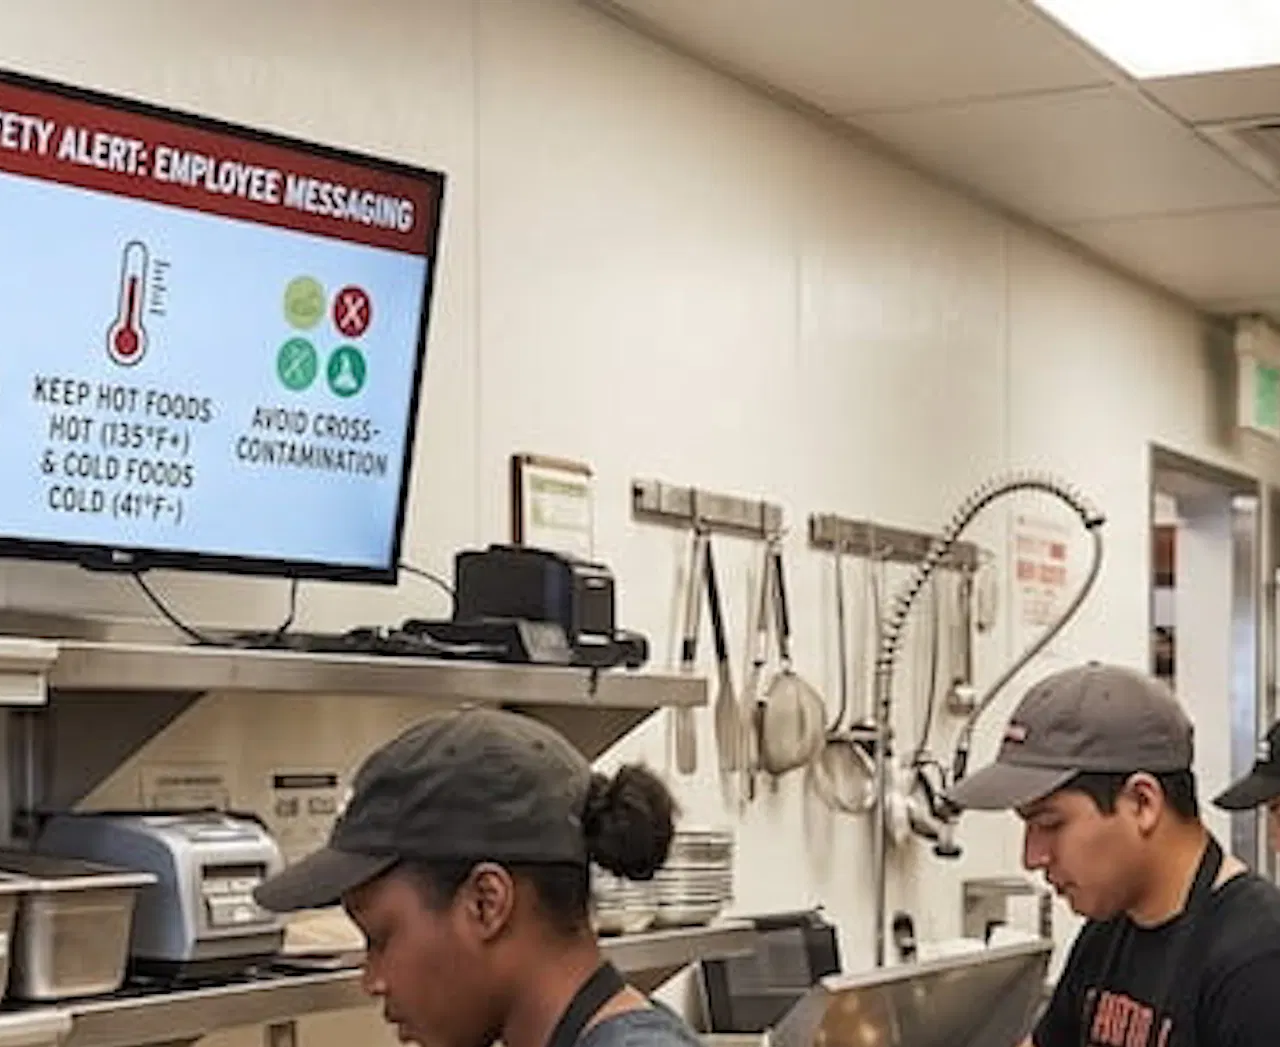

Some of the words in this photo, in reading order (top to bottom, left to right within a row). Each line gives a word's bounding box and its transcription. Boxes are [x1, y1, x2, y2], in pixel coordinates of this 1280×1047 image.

[57, 126, 147, 176] ALERT:
[153, 146, 282, 205] EMPLOYEE
[284, 172, 415, 232] MESSAGING
[33, 373, 90, 406] KEEP
[96, 382, 139, 413] HOT
[145, 389, 213, 424] FOODS
[48, 412, 94, 443] HOT
[251, 405, 309, 436] AVOID
[312, 412, 382, 444] CROSS-
[40, 449, 57, 475] &
[63, 450, 120, 481] COLD
[125, 457, 194, 488] FOODS
[236, 435, 389, 477] CONTAMINATION
[48, 484, 104, 513] COLD
